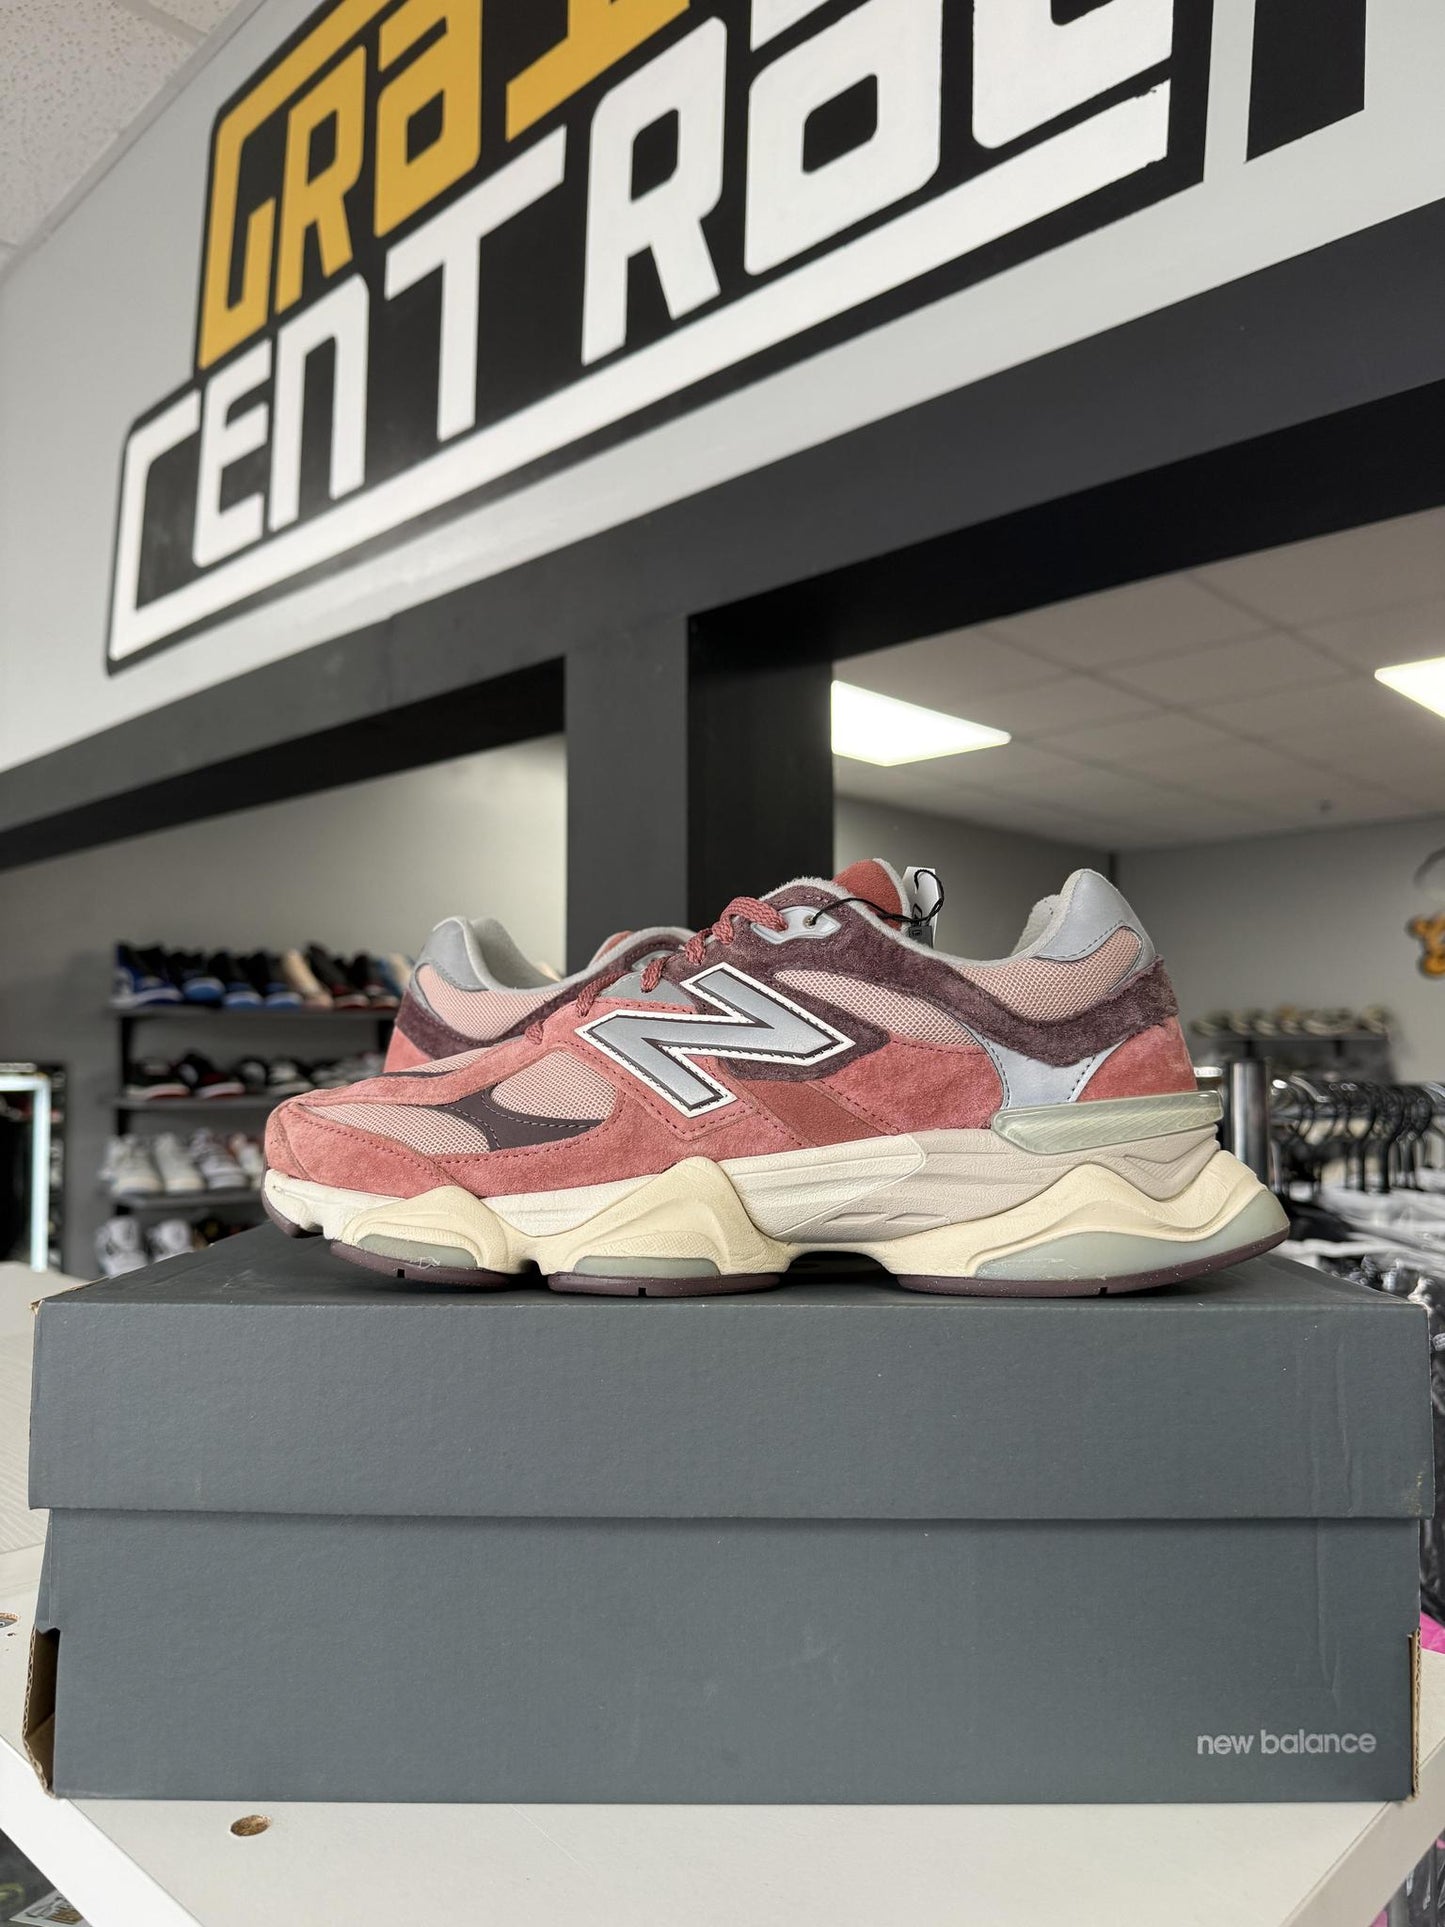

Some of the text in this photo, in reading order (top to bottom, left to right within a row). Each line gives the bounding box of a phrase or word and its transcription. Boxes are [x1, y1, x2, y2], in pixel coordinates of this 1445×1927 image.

[574, 961, 856, 1119] N
[1196, 1729, 1377, 1755] new balance
